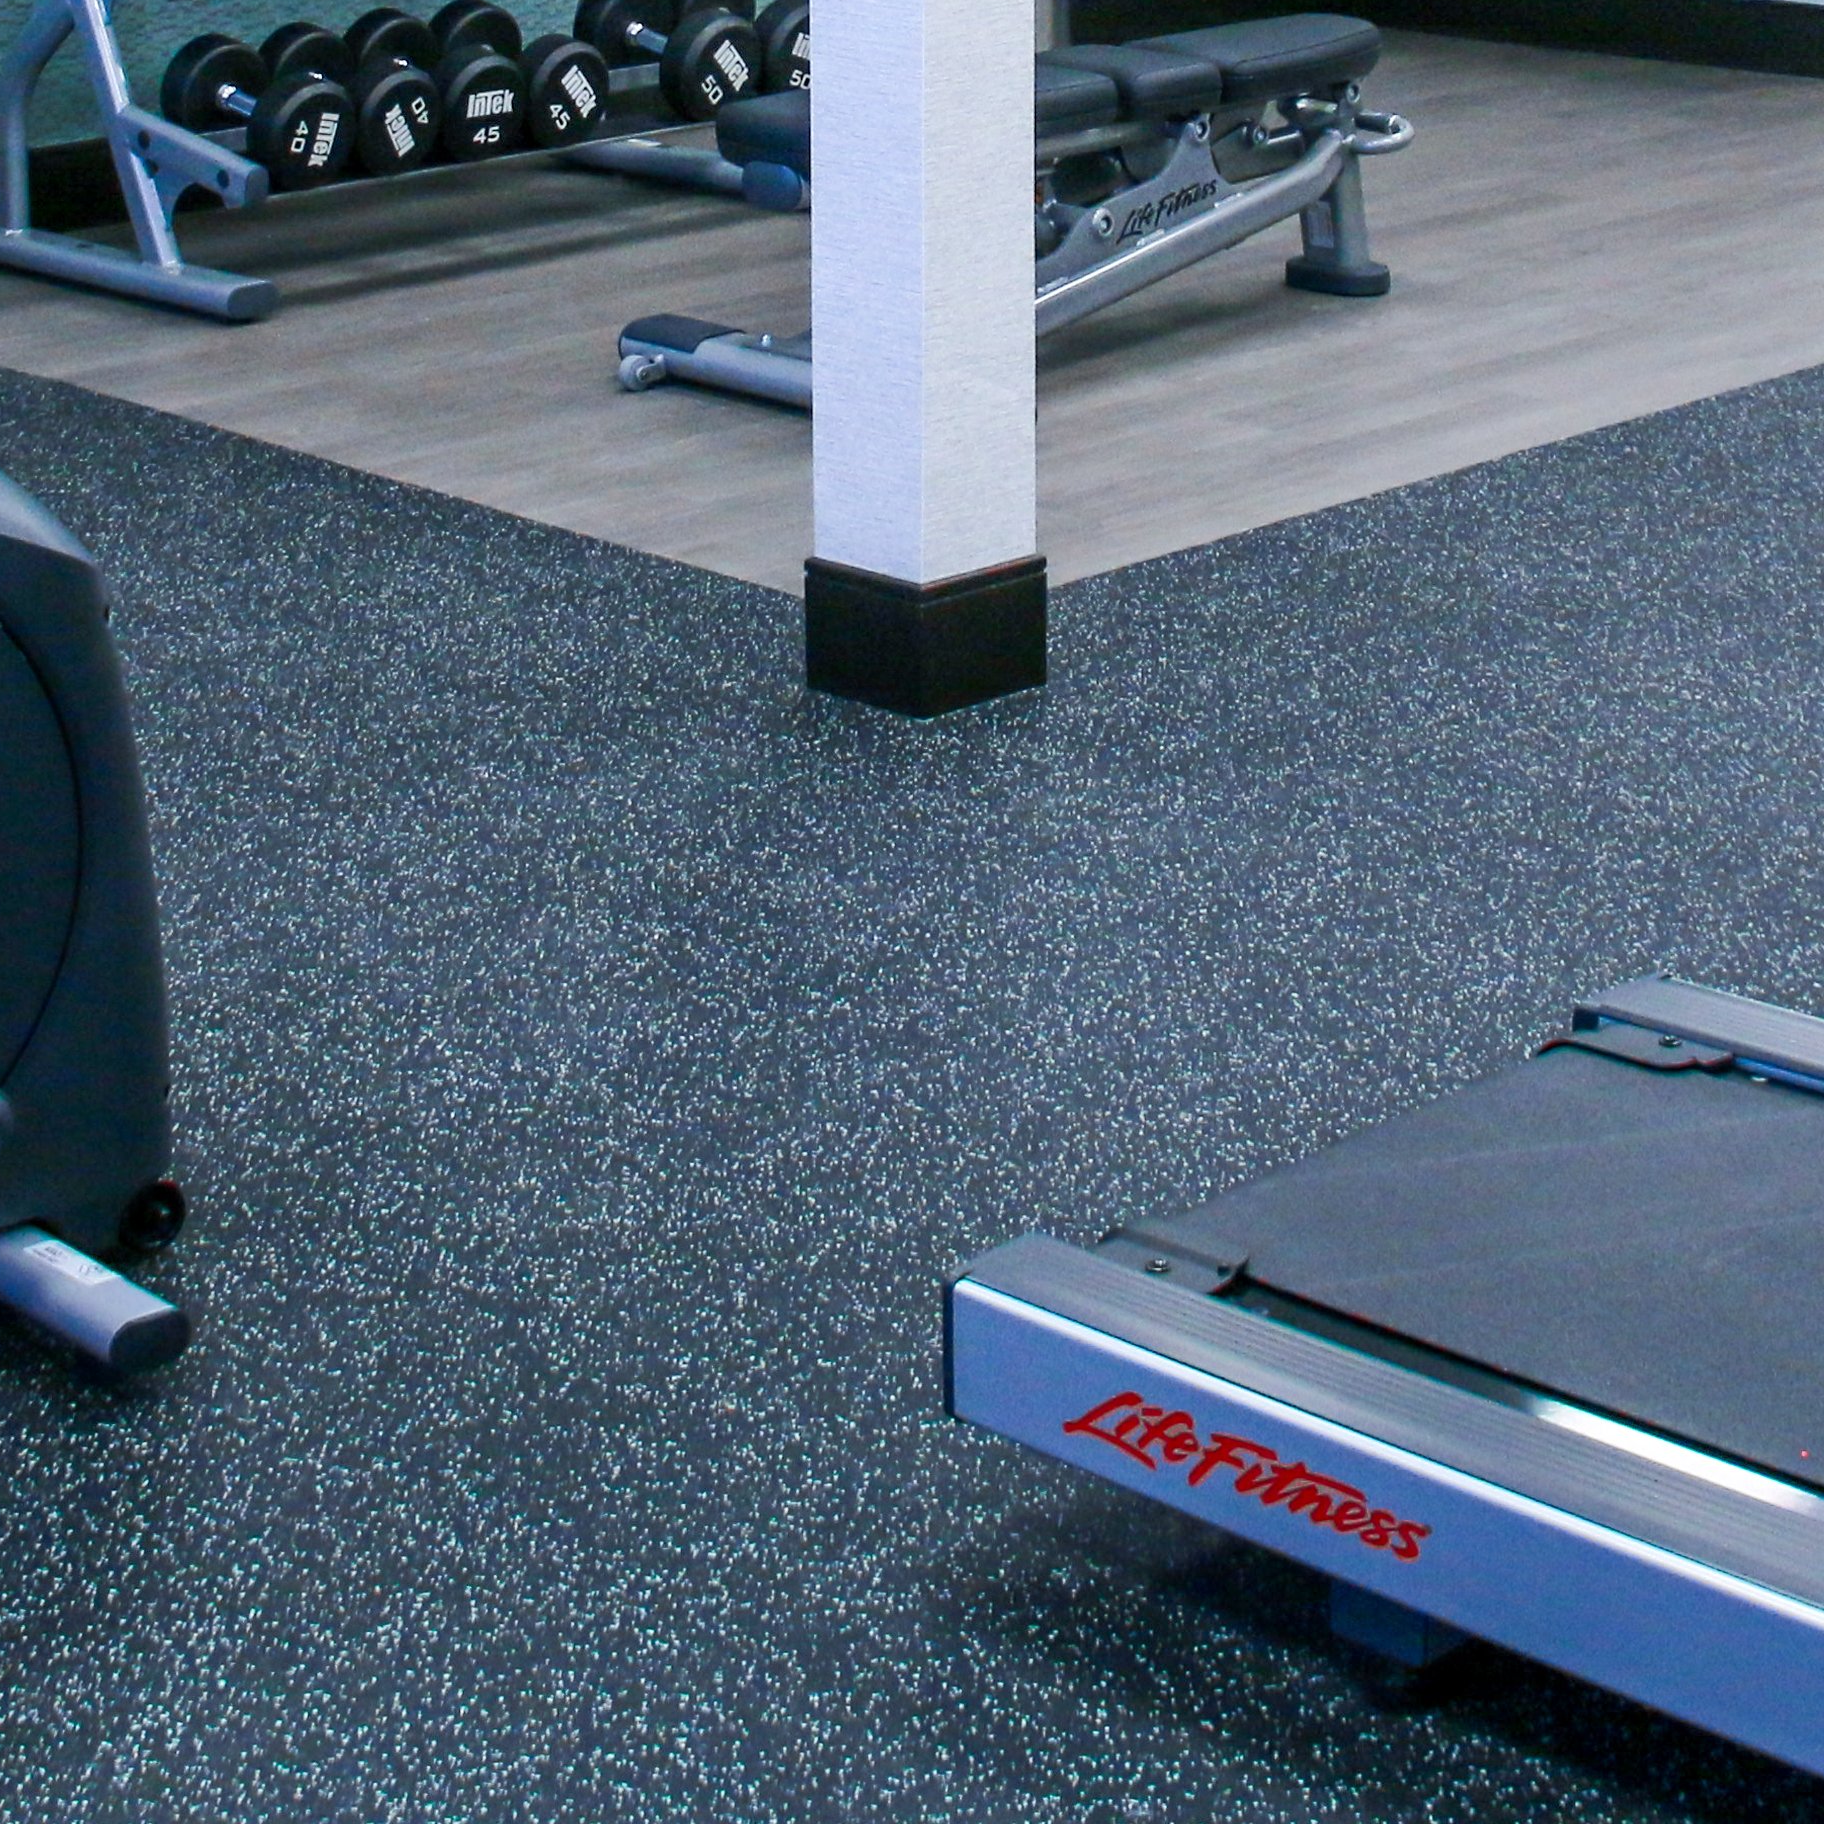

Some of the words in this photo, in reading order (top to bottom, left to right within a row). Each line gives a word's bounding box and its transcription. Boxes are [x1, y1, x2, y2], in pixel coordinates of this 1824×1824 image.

[702, 75, 723, 104] 50
[790, 70, 810, 89] 50
[412, 97, 428, 123] 40
[550, 105, 570, 129] 45
[291, 121, 308, 152] 40
[473, 126, 499, 143] 45
